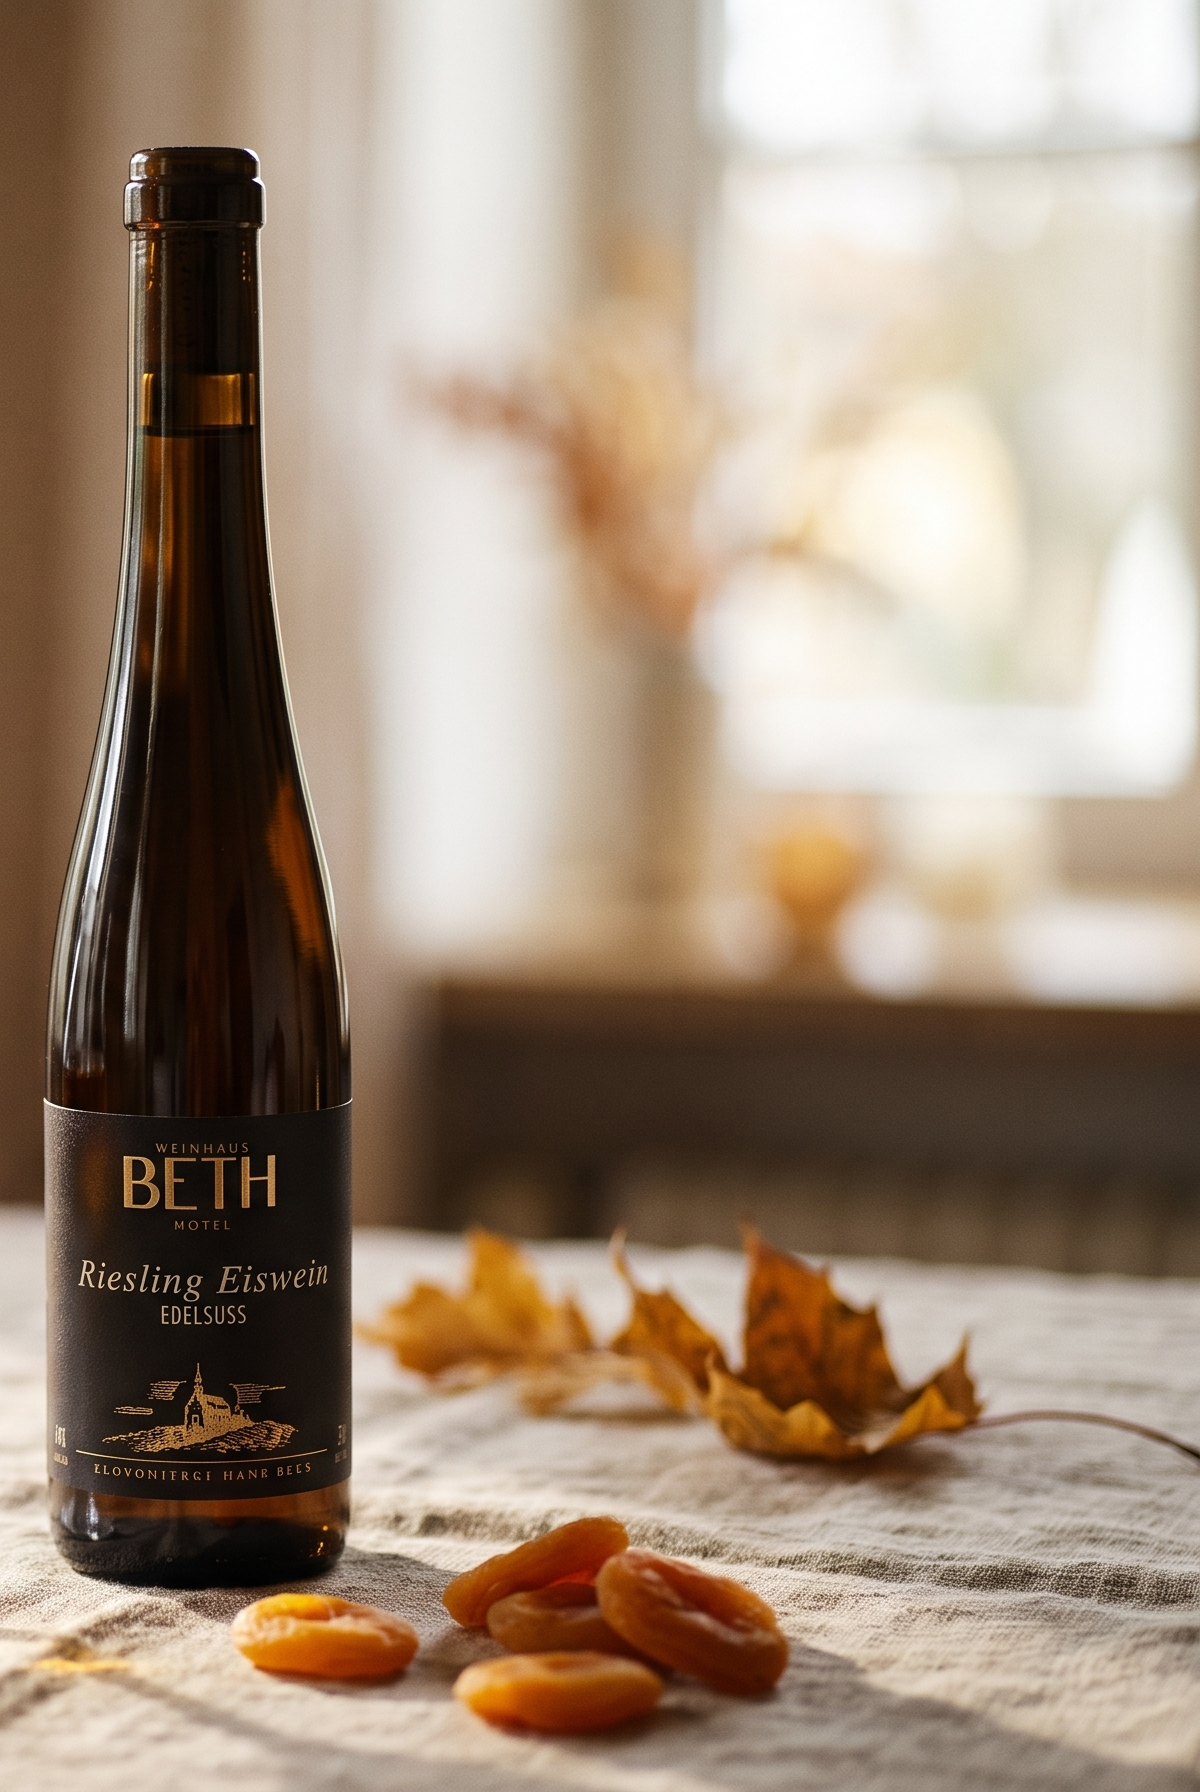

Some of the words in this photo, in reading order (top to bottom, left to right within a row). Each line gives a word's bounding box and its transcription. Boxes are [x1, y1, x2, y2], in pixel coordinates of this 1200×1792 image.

[155, 1142, 250, 1154] WEINHAUS
[123, 1154, 276, 1210] BETH
[174, 1219, 231, 1231] MOTEL
[78, 1259, 204, 1302] Riesling
[216, 1259, 329, 1294] Eiswein
[161, 1304, 247, 1326] EDELSUSS
